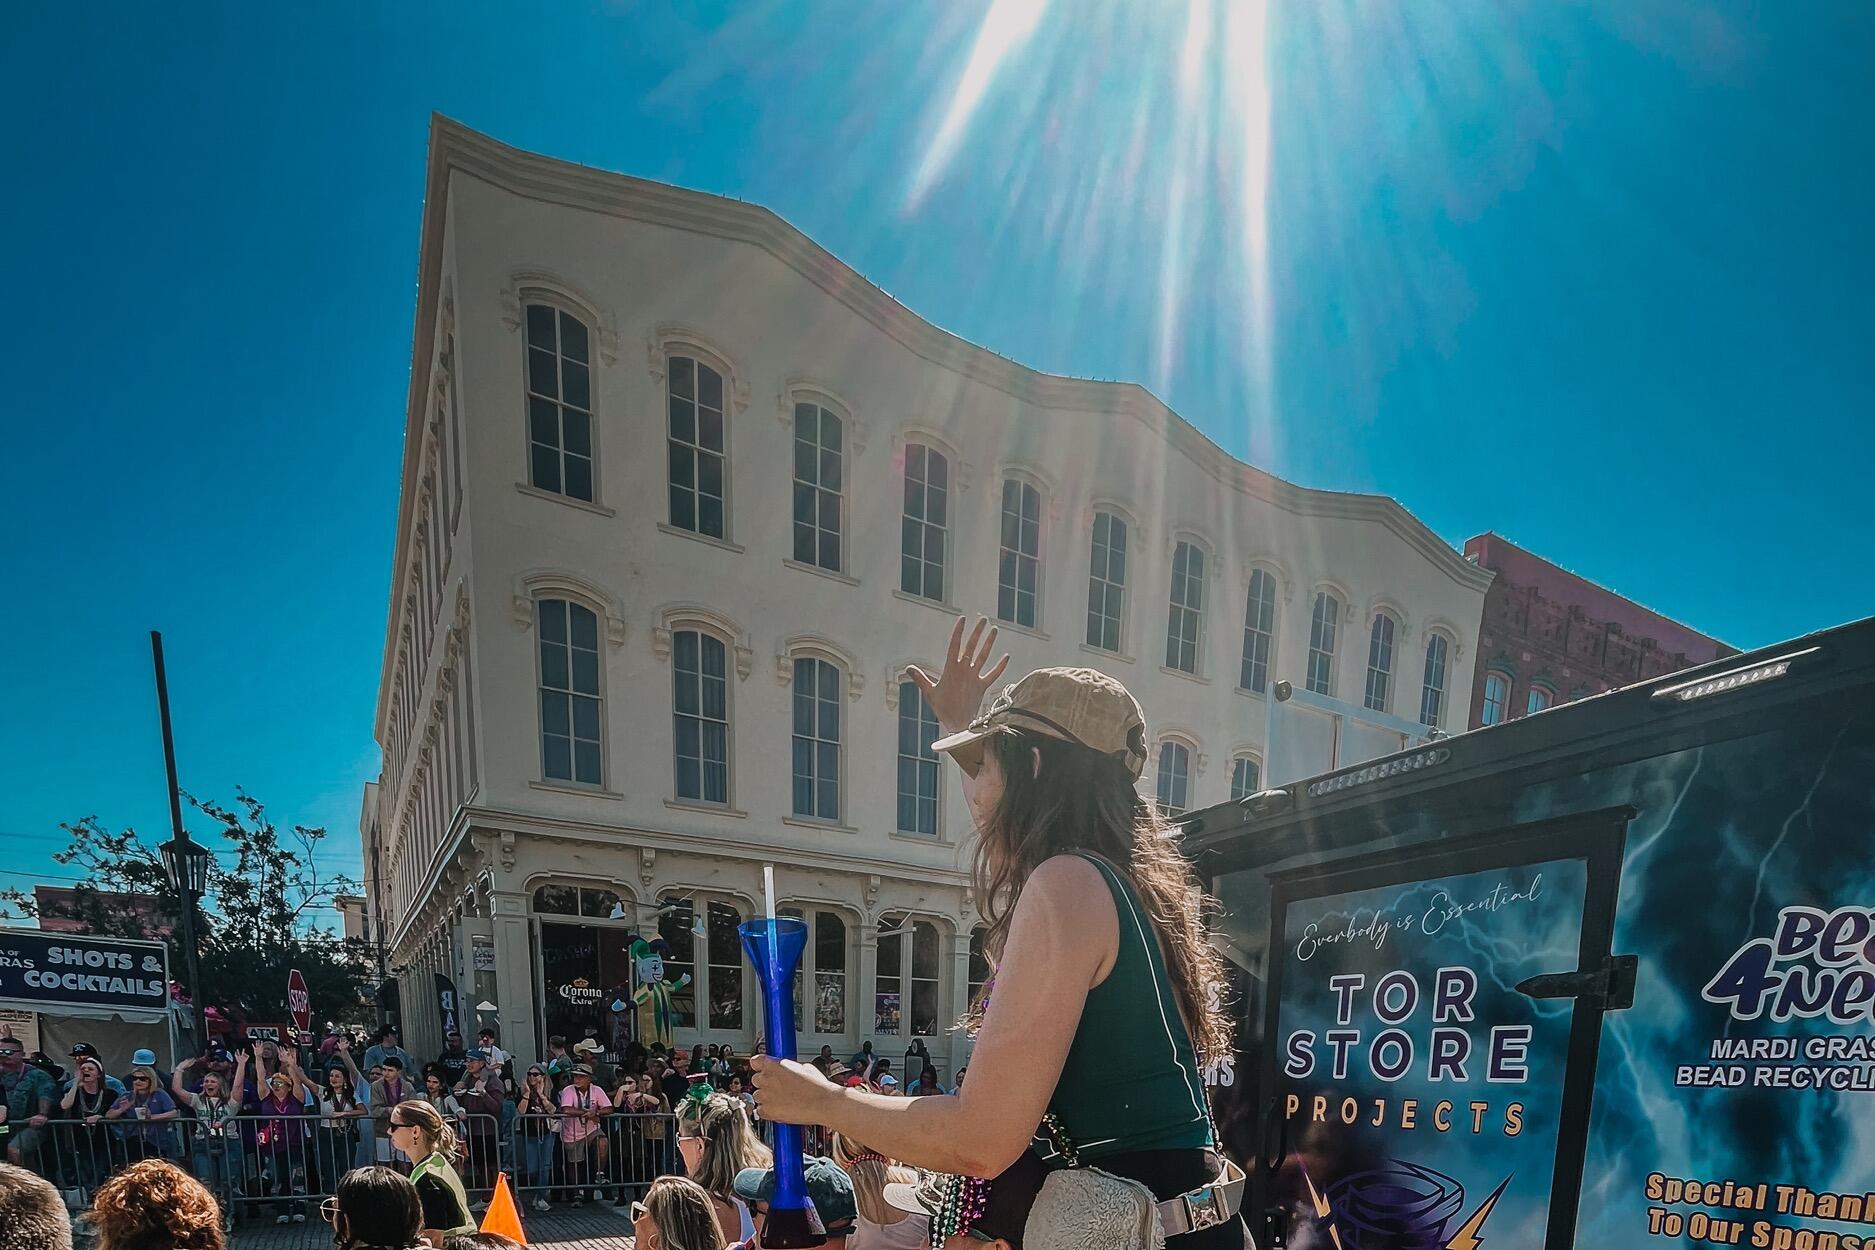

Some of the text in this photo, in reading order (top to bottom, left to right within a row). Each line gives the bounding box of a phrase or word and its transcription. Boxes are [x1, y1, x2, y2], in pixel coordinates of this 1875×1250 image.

[1396, 913, 1416, 931] is
[1422, 873, 1543, 935] Essential
[1775, 906, 1875, 966] Be
[48, 947, 163, 972] SHOTS &
[24, 970, 164, 996] COCKTAILS
[560, 984, 602, 999] Corona
[1329, 966, 1478, 1025] TOR
[290, 989, 307, 1012] STOP
[571, 996, 592, 1005] Extra
[1284, 1025, 1532, 1082] STORE
[1710, 1038, 1798, 1059] MARDI
[1675, 1066, 1746, 1086] BEAD
[1285, 1094, 1524, 1137] PROJECTS
[1647, 1174, 1767, 1210] Special
[1649, 1208, 1682, 1236] To
[1690, 1213, 1744, 1244] Our
